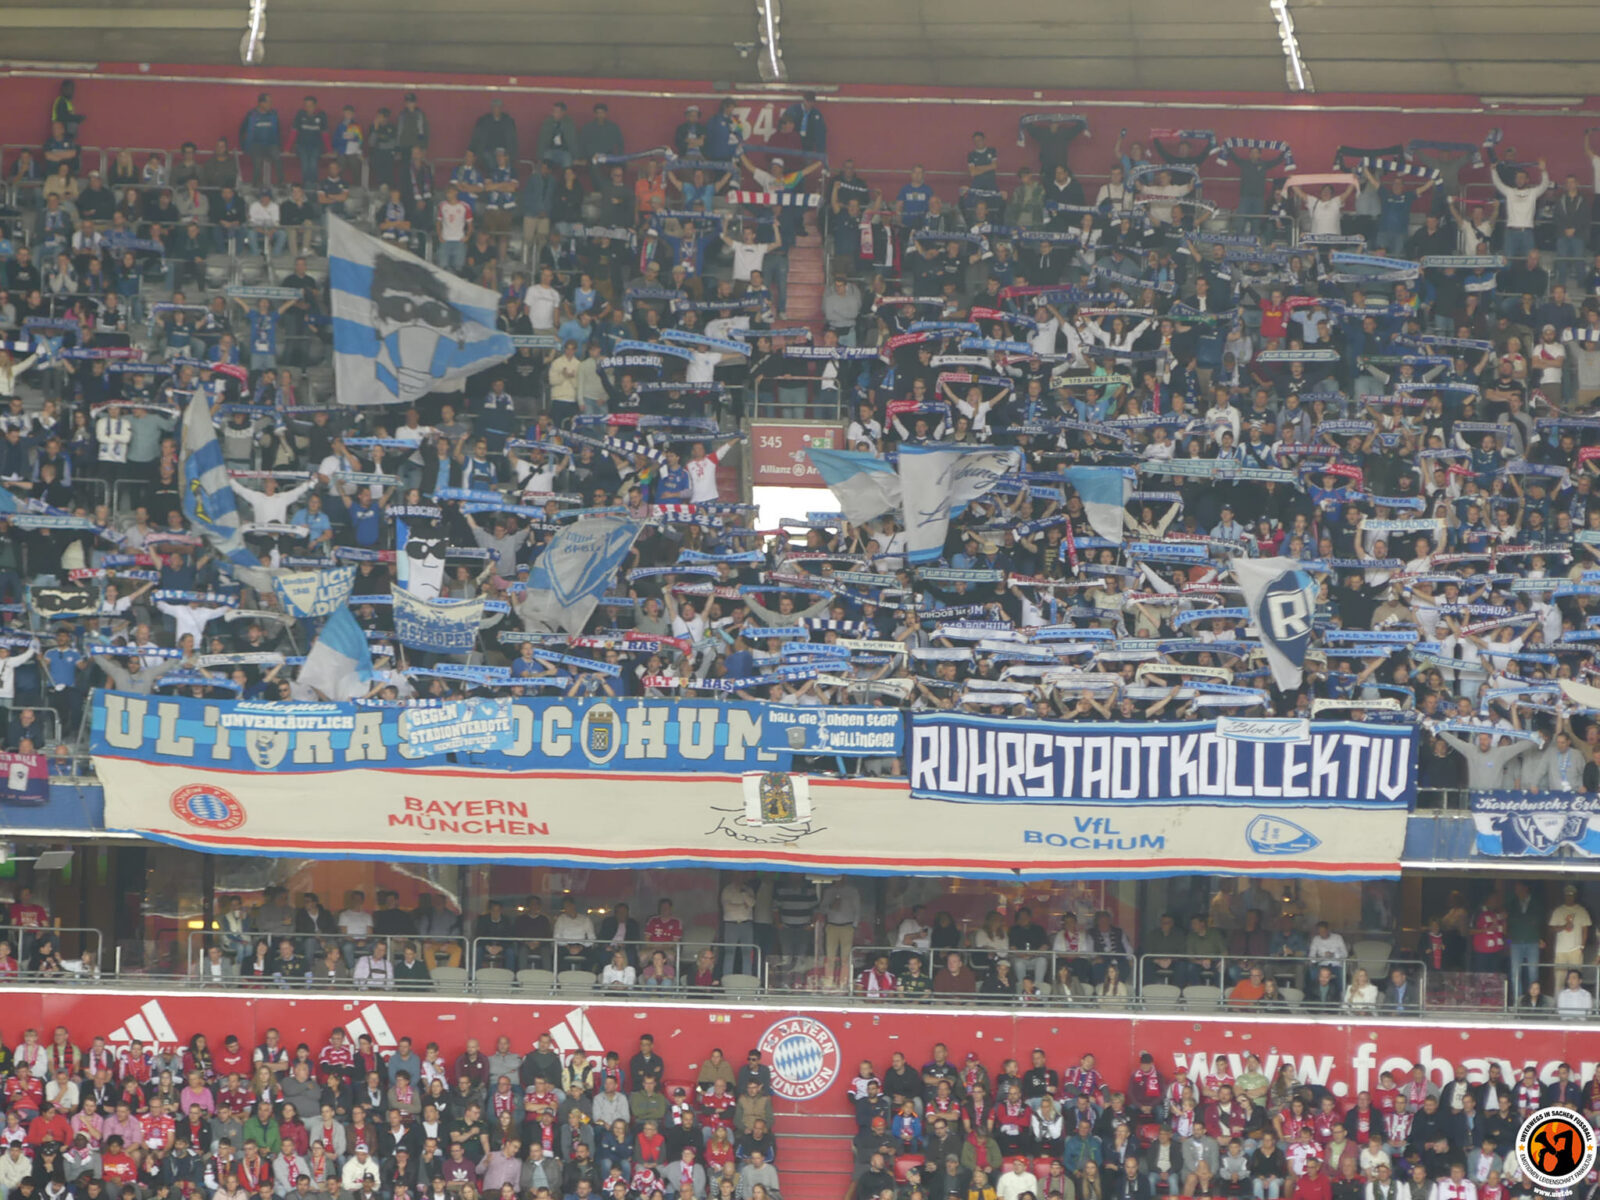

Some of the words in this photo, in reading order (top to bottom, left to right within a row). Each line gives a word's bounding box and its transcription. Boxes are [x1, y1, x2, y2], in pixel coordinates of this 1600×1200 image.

[759, 435, 782, 448] 345
[759, 464, 792, 475] Allianz
[1365, 518, 1440, 529] RUHRSTADION
[1267, 595, 1309, 640] R
[398, 621, 477, 647] ASTROPER
[627, 640, 660, 652] RAS
[703, 677, 734, 692] RAS
[221, 713, 355, 730] UNVERKÄUFLICH
[411, 703, 458, 727] GEGEN
[410, 718, 511, 746] STADIONVERBOTE
[911, 725, 1411, 802] RUHRSTADTKOLLEKTIV
[404, 796, 529, 818] BAYERN
[387, 812, 550, 836] MÜNCHEN
[1072, 815, 1121, 835] VfL
[1023, 829, 1166, 851] BOCHUM
